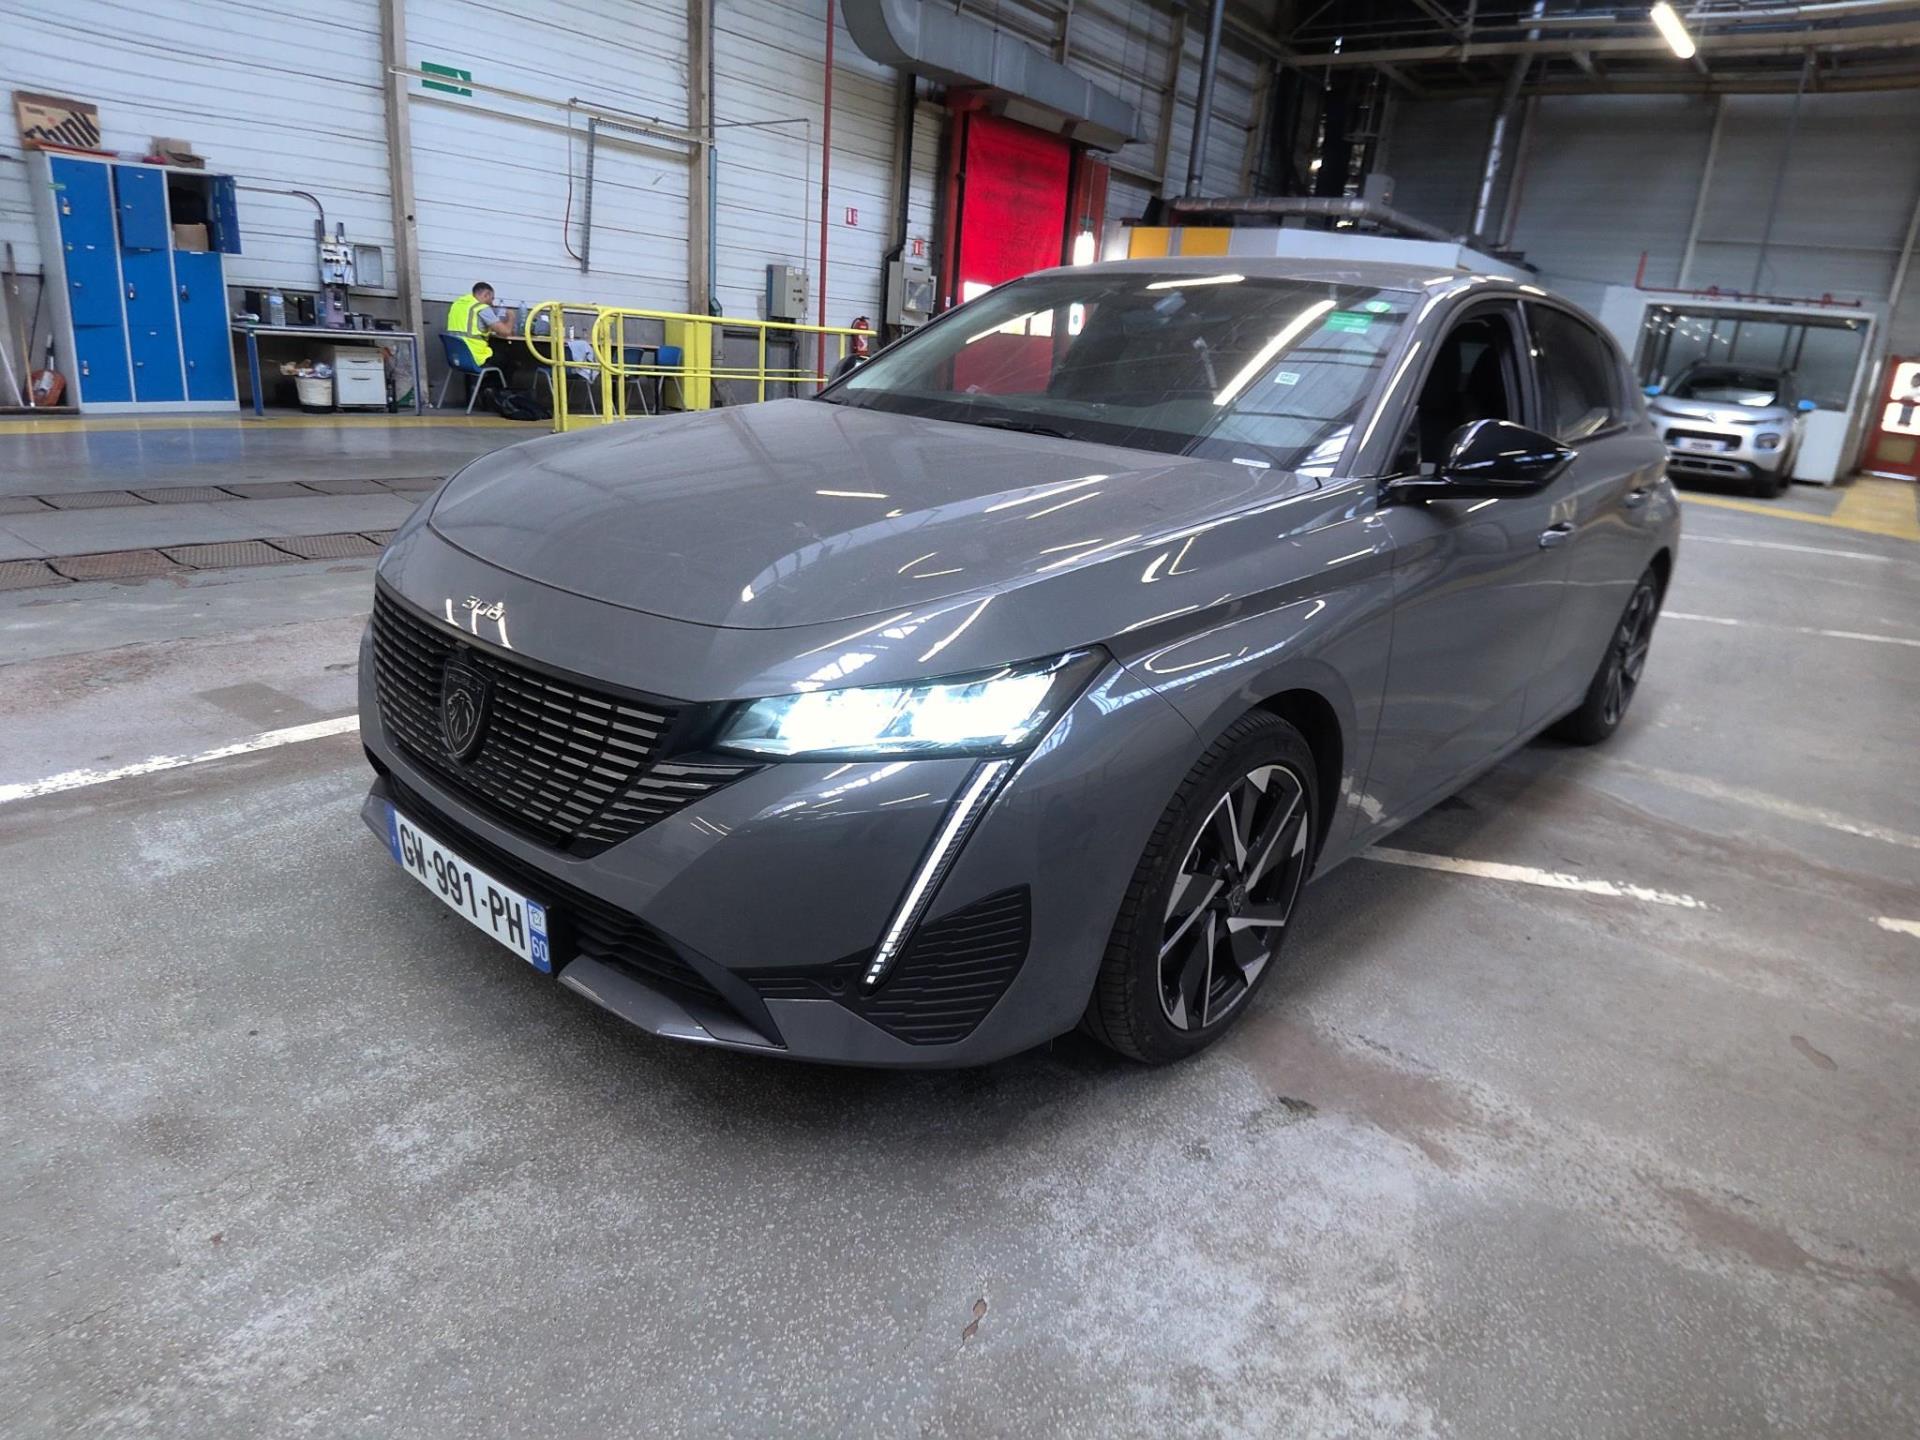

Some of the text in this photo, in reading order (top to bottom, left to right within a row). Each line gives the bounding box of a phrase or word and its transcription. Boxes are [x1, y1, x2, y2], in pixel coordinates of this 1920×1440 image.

[462, 595, 506, 621] 308
[400, 823, 525, 951] GW-991-PH
[531, 936, 549, 962] 60
